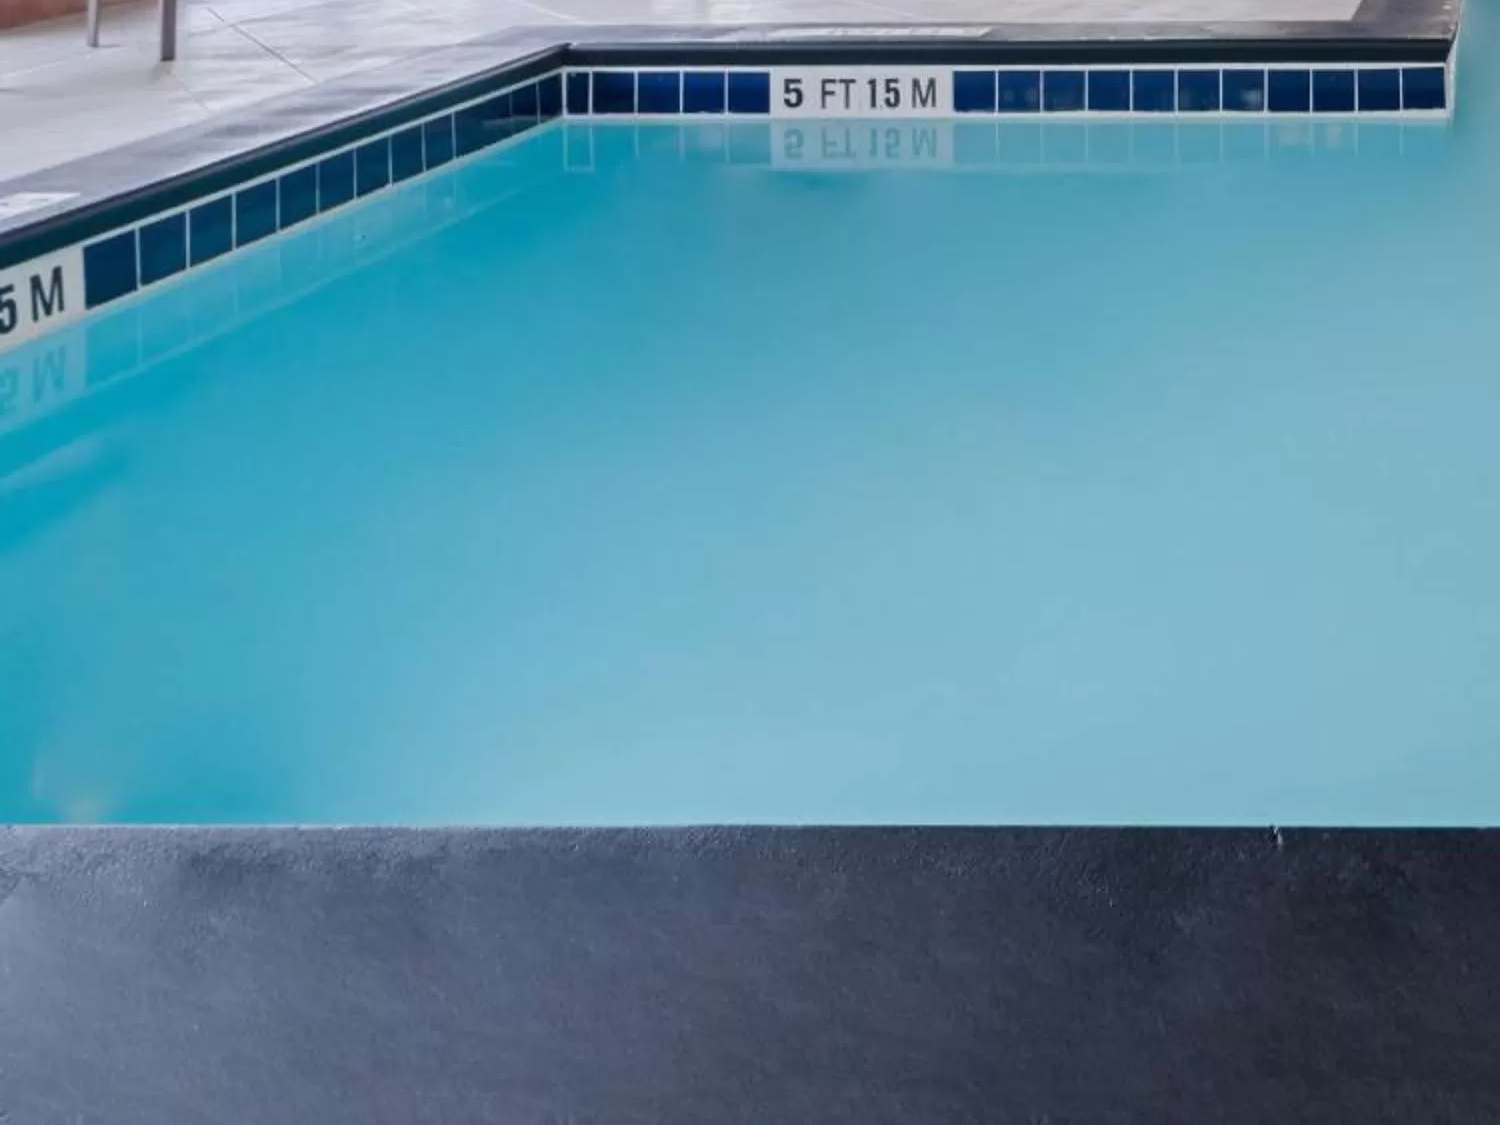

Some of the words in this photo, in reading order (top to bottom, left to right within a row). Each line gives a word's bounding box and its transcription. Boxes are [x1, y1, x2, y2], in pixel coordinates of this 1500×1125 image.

[783, 78, 804, 108] 5
[821, 78, 857, 109] FT
[911, 77, 937, 109] M
[29, 265, 65, 323] M
